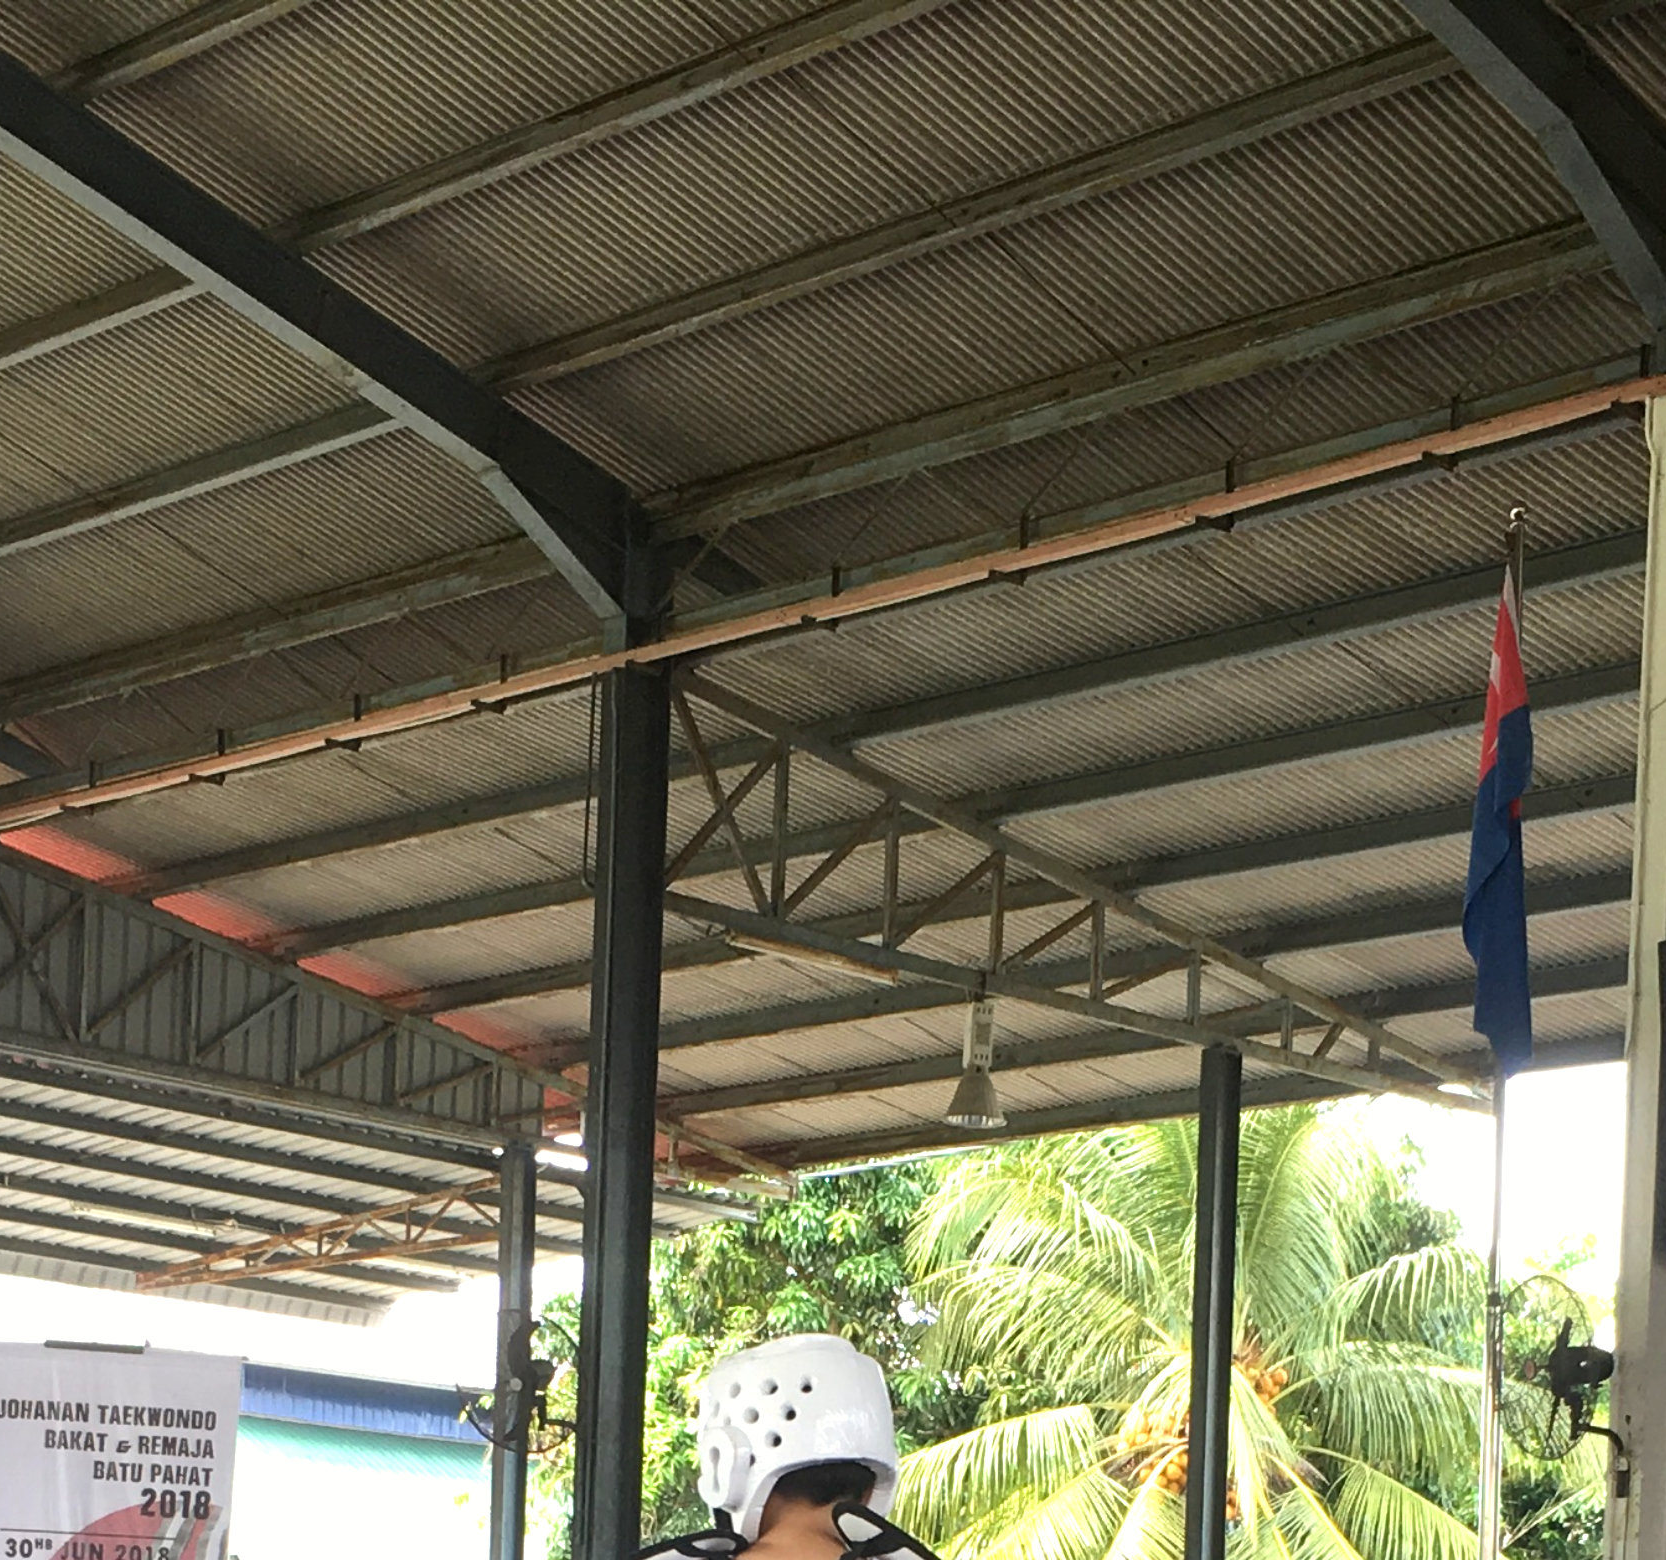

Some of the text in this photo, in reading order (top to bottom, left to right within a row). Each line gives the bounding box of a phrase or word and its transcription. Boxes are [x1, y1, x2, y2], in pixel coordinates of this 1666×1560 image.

[97, 1404, 217, 1431] TAEKWONDO
[44, 1429, 108, 1453] BAKAT
[138, 1435, 214, 1459] REMAJA
[93, 1460, 213, 1487] BATU PAHAT
[140, 1488, 212, 1520] 2018
